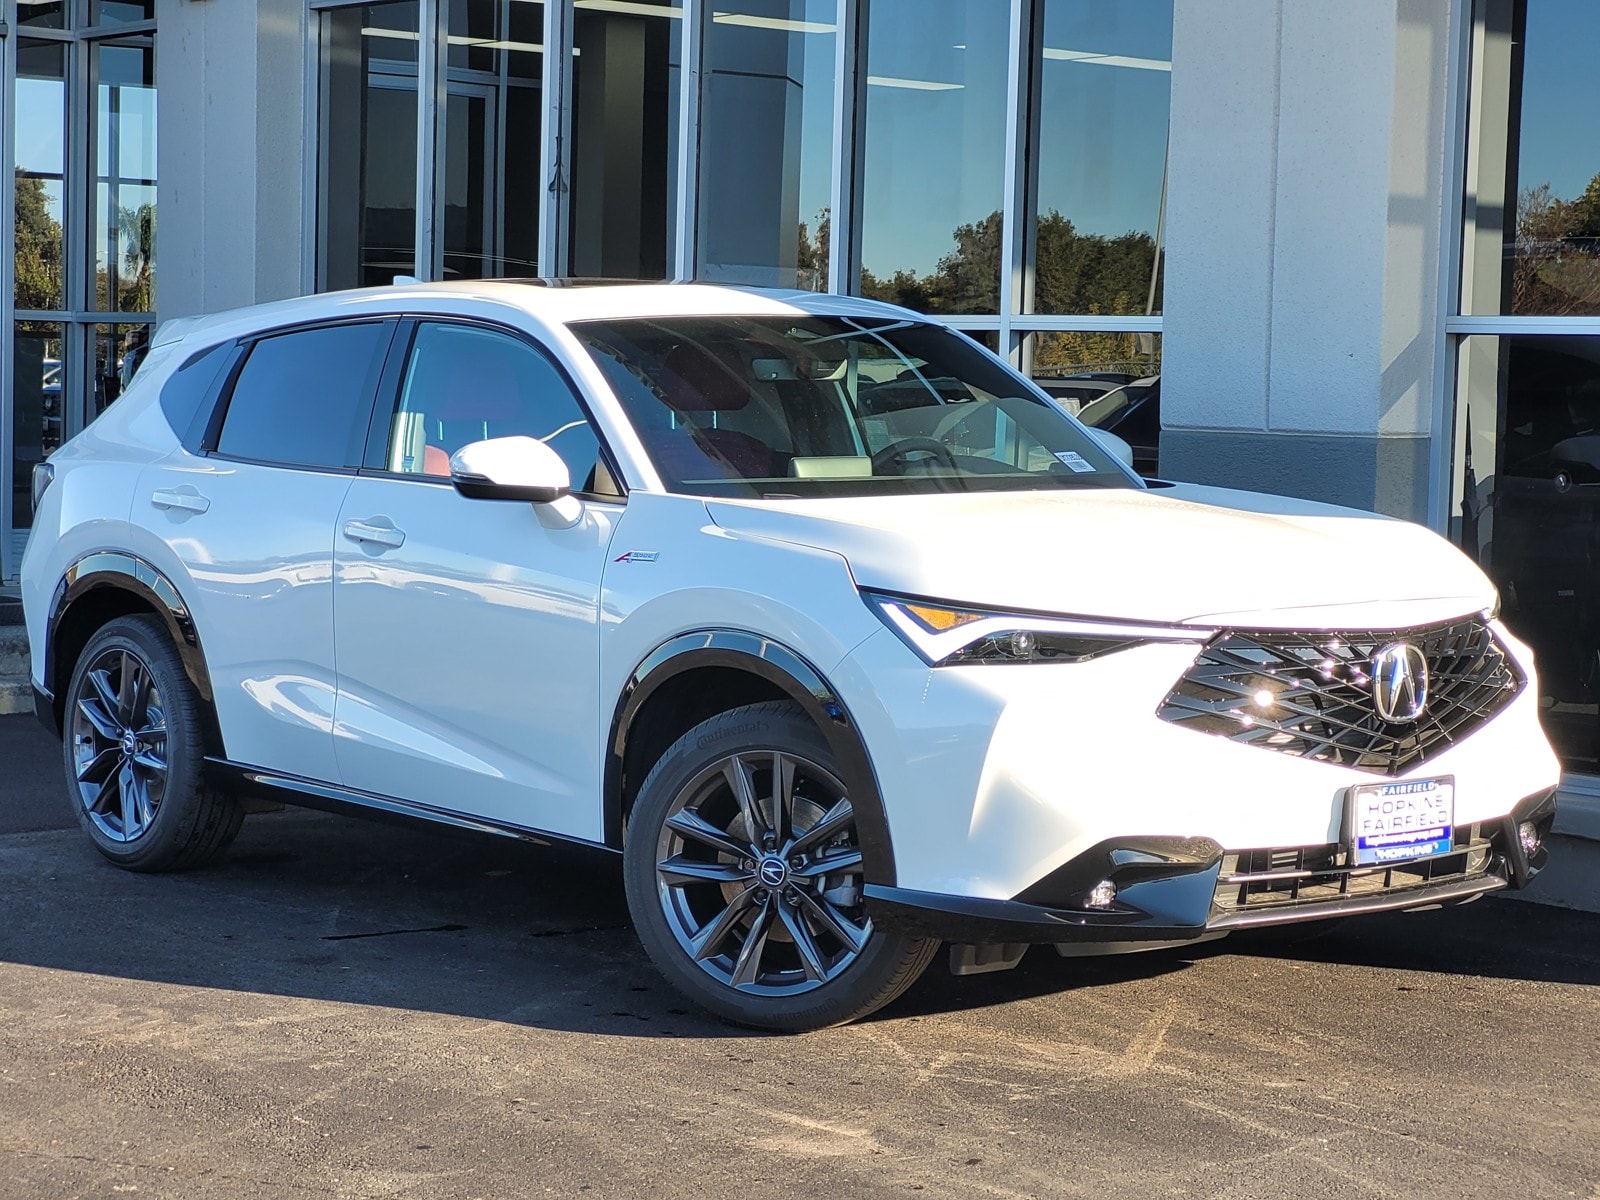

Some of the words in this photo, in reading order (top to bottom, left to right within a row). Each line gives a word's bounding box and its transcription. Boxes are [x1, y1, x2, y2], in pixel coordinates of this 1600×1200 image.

[697, 721, 760, 749] Continental
[1382, 782, 1435, 796] FAIRFIELD
[1368, 795, 1443, 814] HOPKINS
[1363, 810, 1448, 832] FAIRFIELD
